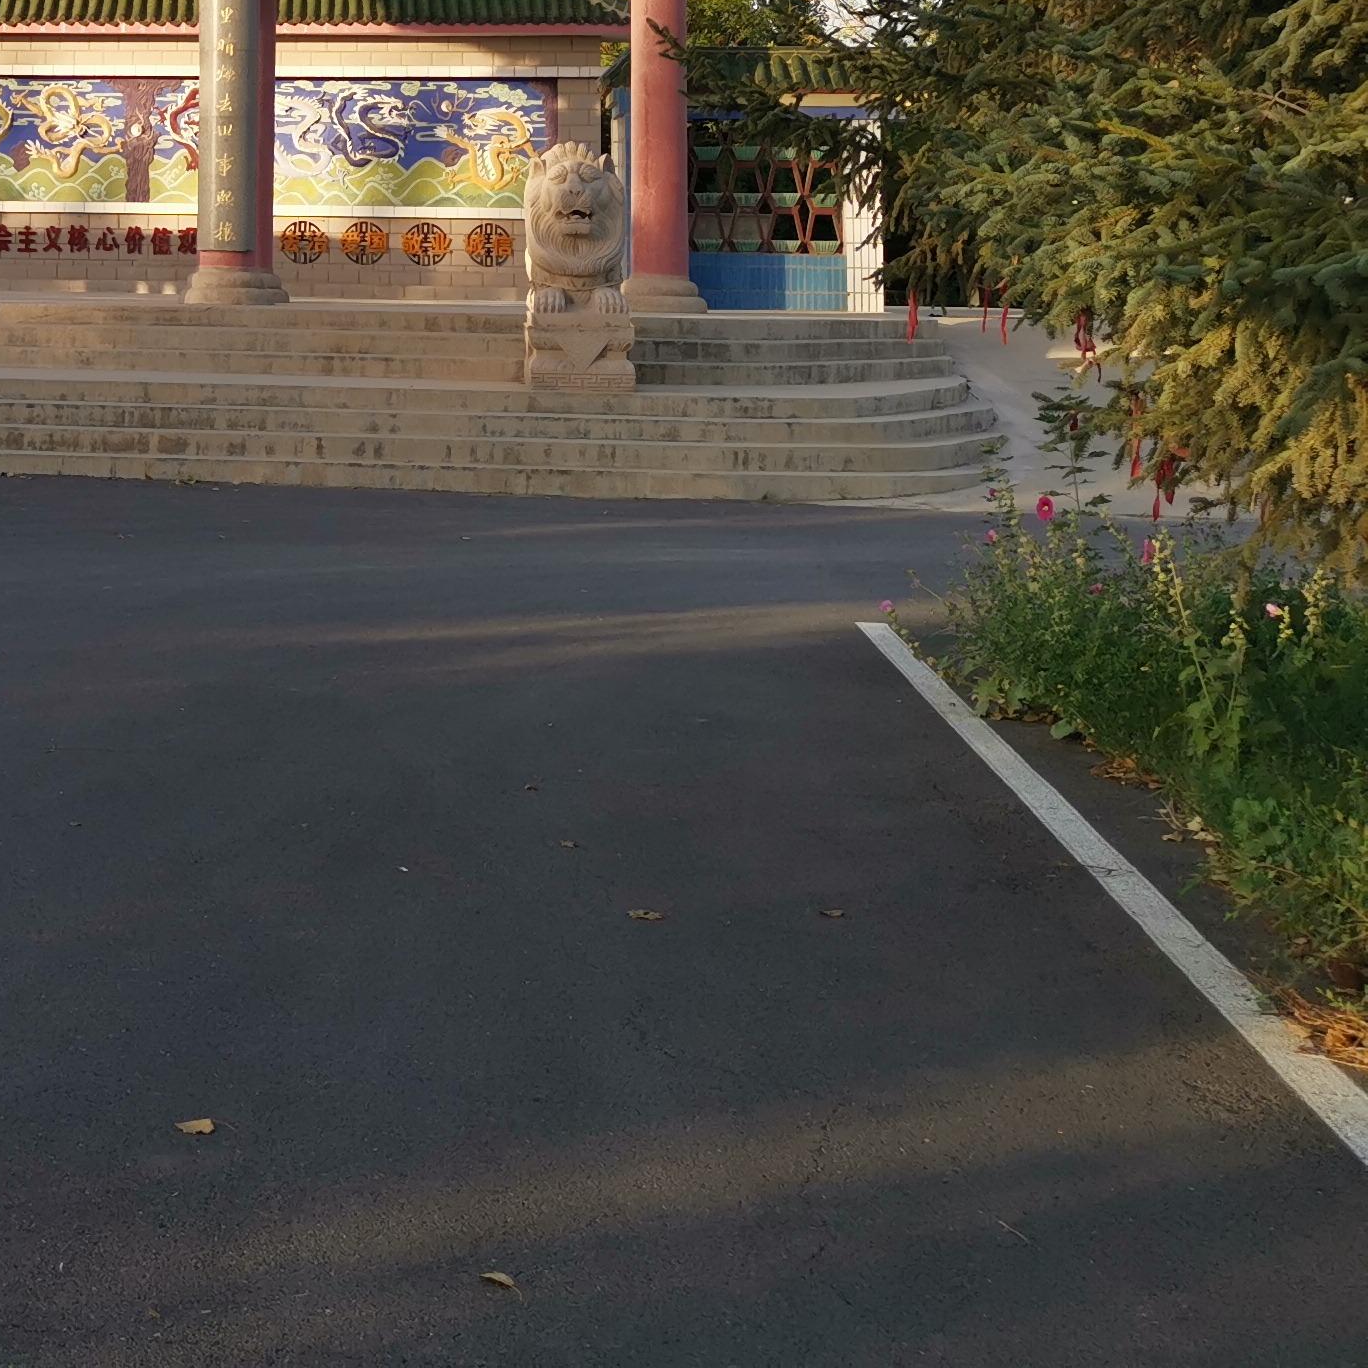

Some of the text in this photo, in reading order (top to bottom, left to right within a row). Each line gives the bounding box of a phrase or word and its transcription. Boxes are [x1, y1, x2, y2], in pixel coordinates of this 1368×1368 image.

[280, 231, 516, 256] 法治 爱国 敬业 诚信
